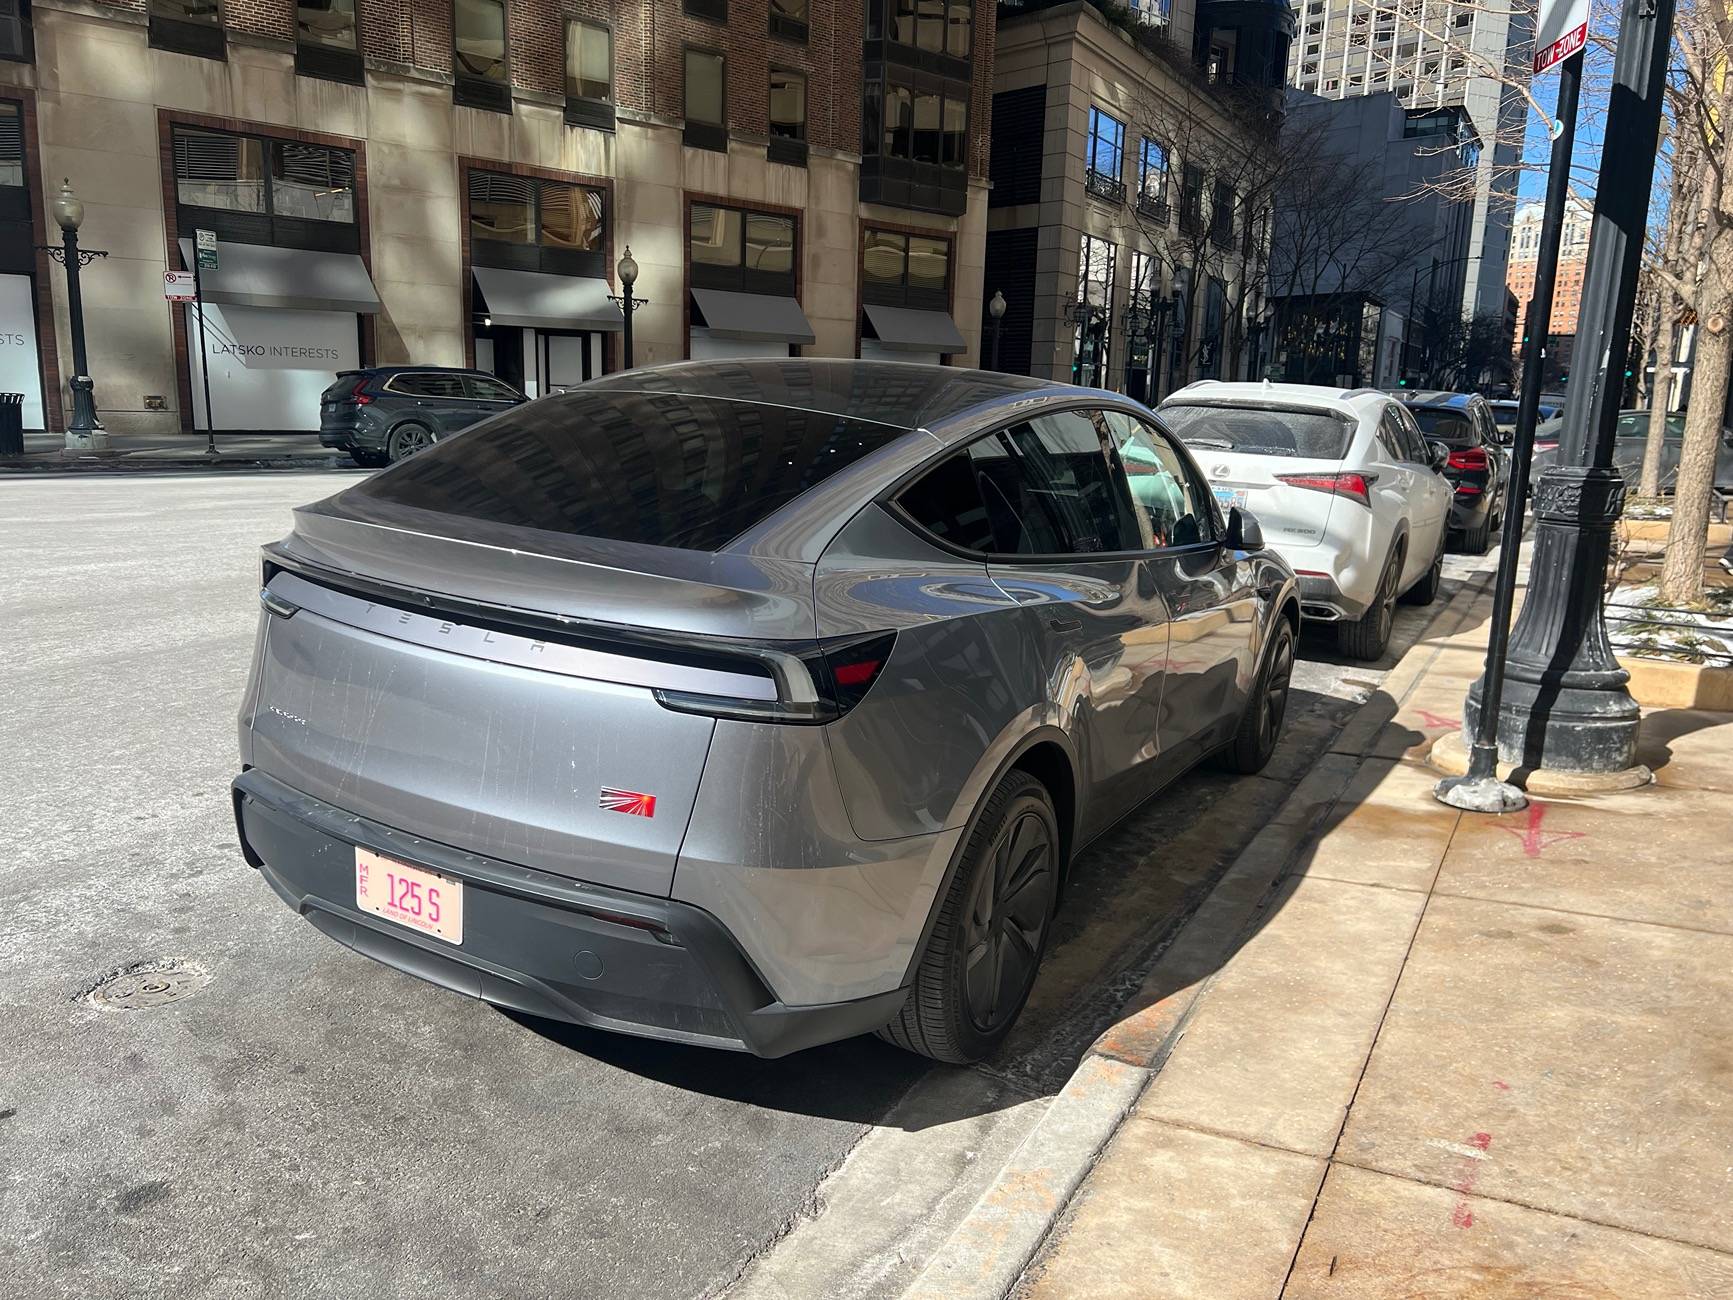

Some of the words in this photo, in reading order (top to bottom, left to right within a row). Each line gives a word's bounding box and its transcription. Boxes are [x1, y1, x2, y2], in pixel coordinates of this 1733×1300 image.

[1537, 45, 1555, 70] TOW
[1558, 27, 1582, 58] ZONE
[212, 344, 265, 356] LATSKO
[269, 346, 339, 360] INTERESTS
[366, 603, 546, 653] TESLA
[359, 863, 369, 898] MFR
[387, 873, 422, 916] 125
[428, 887, 440, 922] S
[382, 907, 399, 917] LAND
[399, 912, 408, 920] OF
